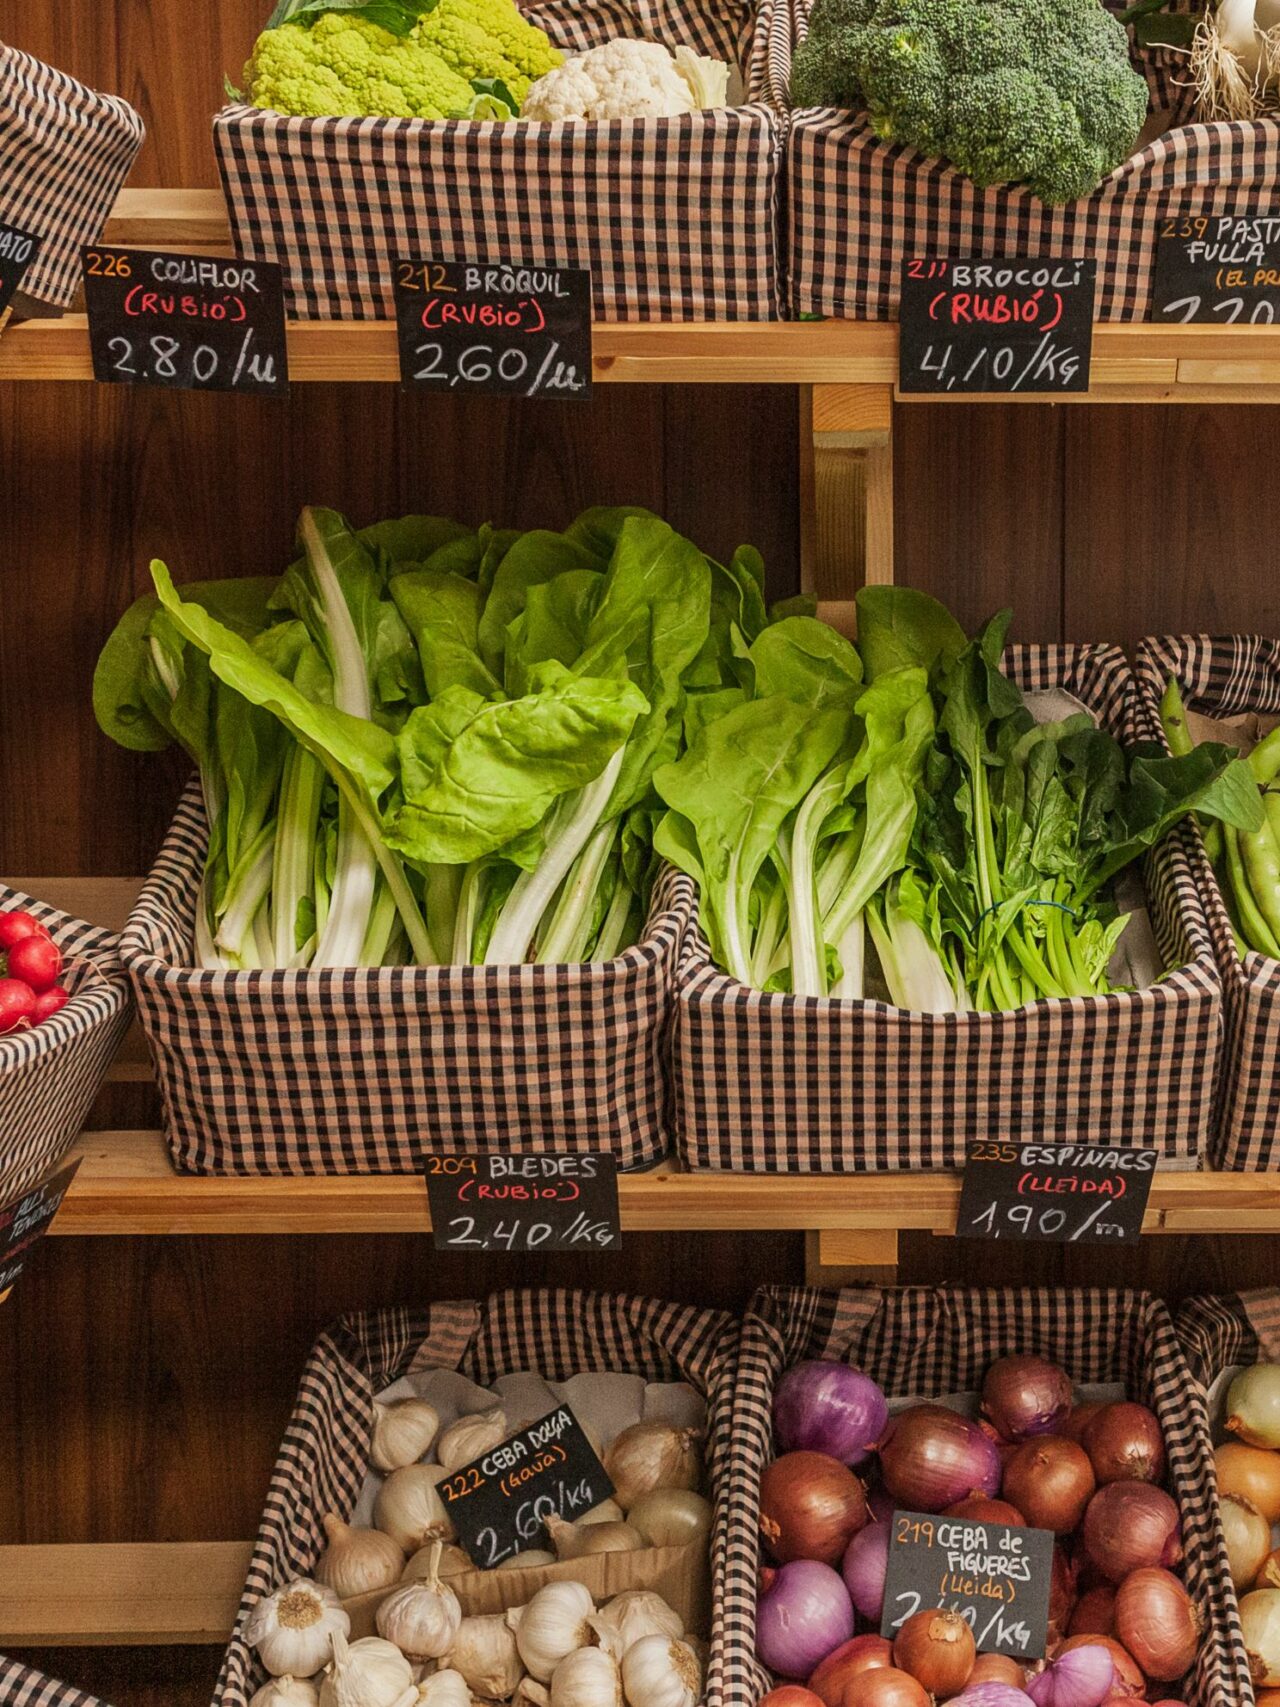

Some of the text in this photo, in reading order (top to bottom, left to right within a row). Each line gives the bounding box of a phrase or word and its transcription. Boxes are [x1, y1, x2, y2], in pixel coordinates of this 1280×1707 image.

[1161, 217, 1209, 240] 239
[0, 231, 33, 263] ATO
[1183, 241, 1266, 266] FULLA
[87, 253, 260, 293] 226 COLIFLOR
[399, 263, 570, 297] 212 BRÒQUIL
[907, 260, 948, 278] 211
[428, 1156, 599, 1178] 209 BLEDES
[971, 1144, 1018, 1163] 235
[442, 1468, 486, 1501] 222
[482, 1440, 528, 1476] CEBA
[897, 1518, 1024, 1554] 219 CEBA de
[947, 1551, 1032, 1581] FIGUERES
